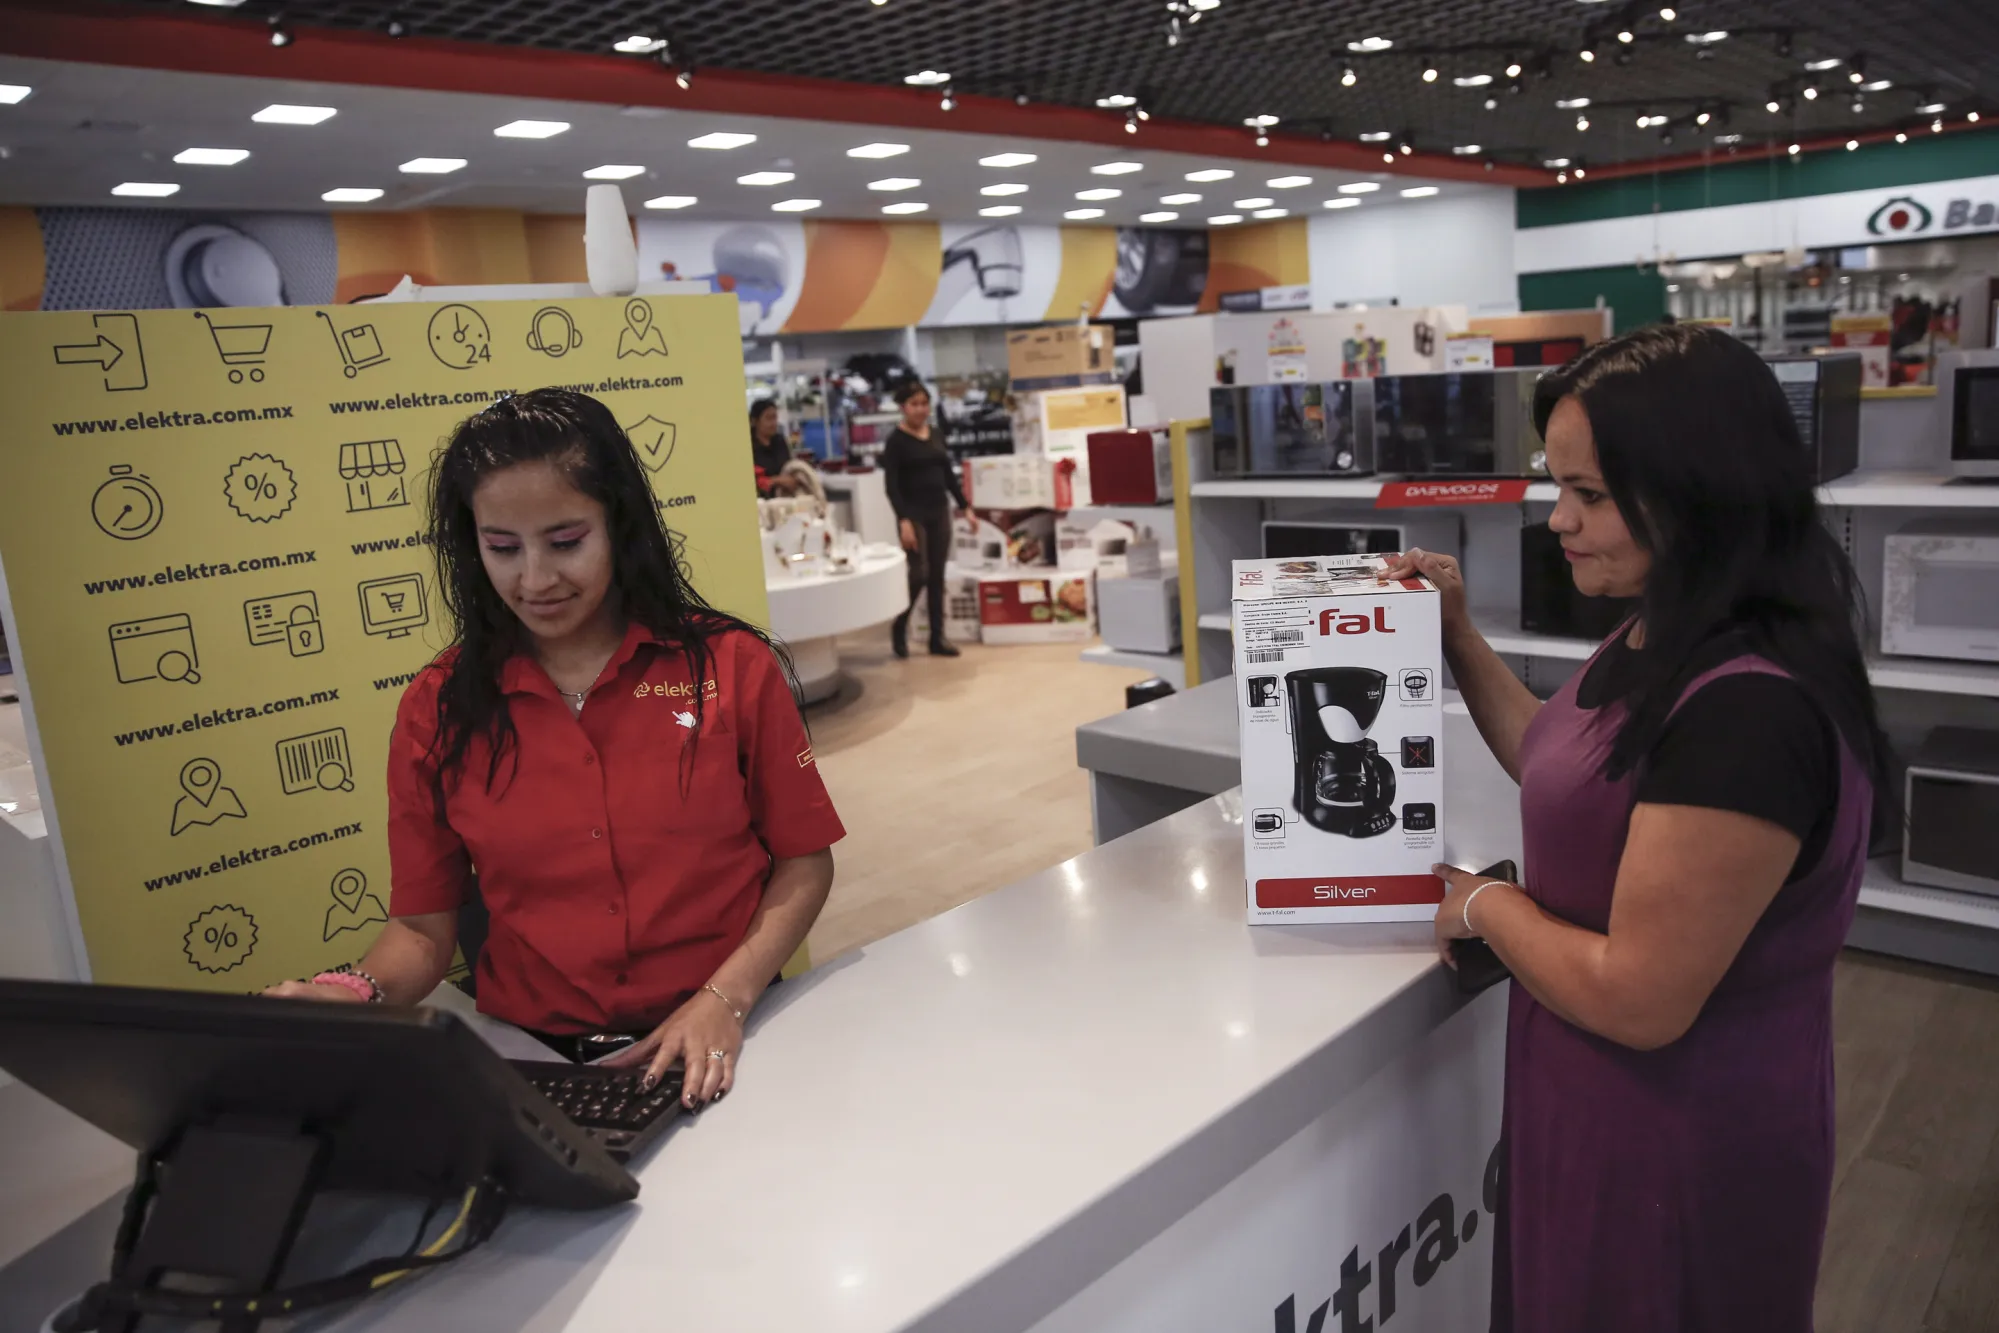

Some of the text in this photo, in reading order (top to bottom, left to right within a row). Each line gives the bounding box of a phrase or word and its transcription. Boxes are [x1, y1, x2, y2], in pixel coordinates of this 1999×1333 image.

[1944, 198, 1999, 229] Ba
[466, 344, 492, 364] 24
[53, 406, 293, 436] www.elektra.com.mx
[84, 549, 317, 595] www.elektra.com.mx
[114, 688, 340, 747] www.elektra.com.mx
[144, 821, 363, 893] www.elektra.com.mx
[1313, 886, 1376, 899] Silver
